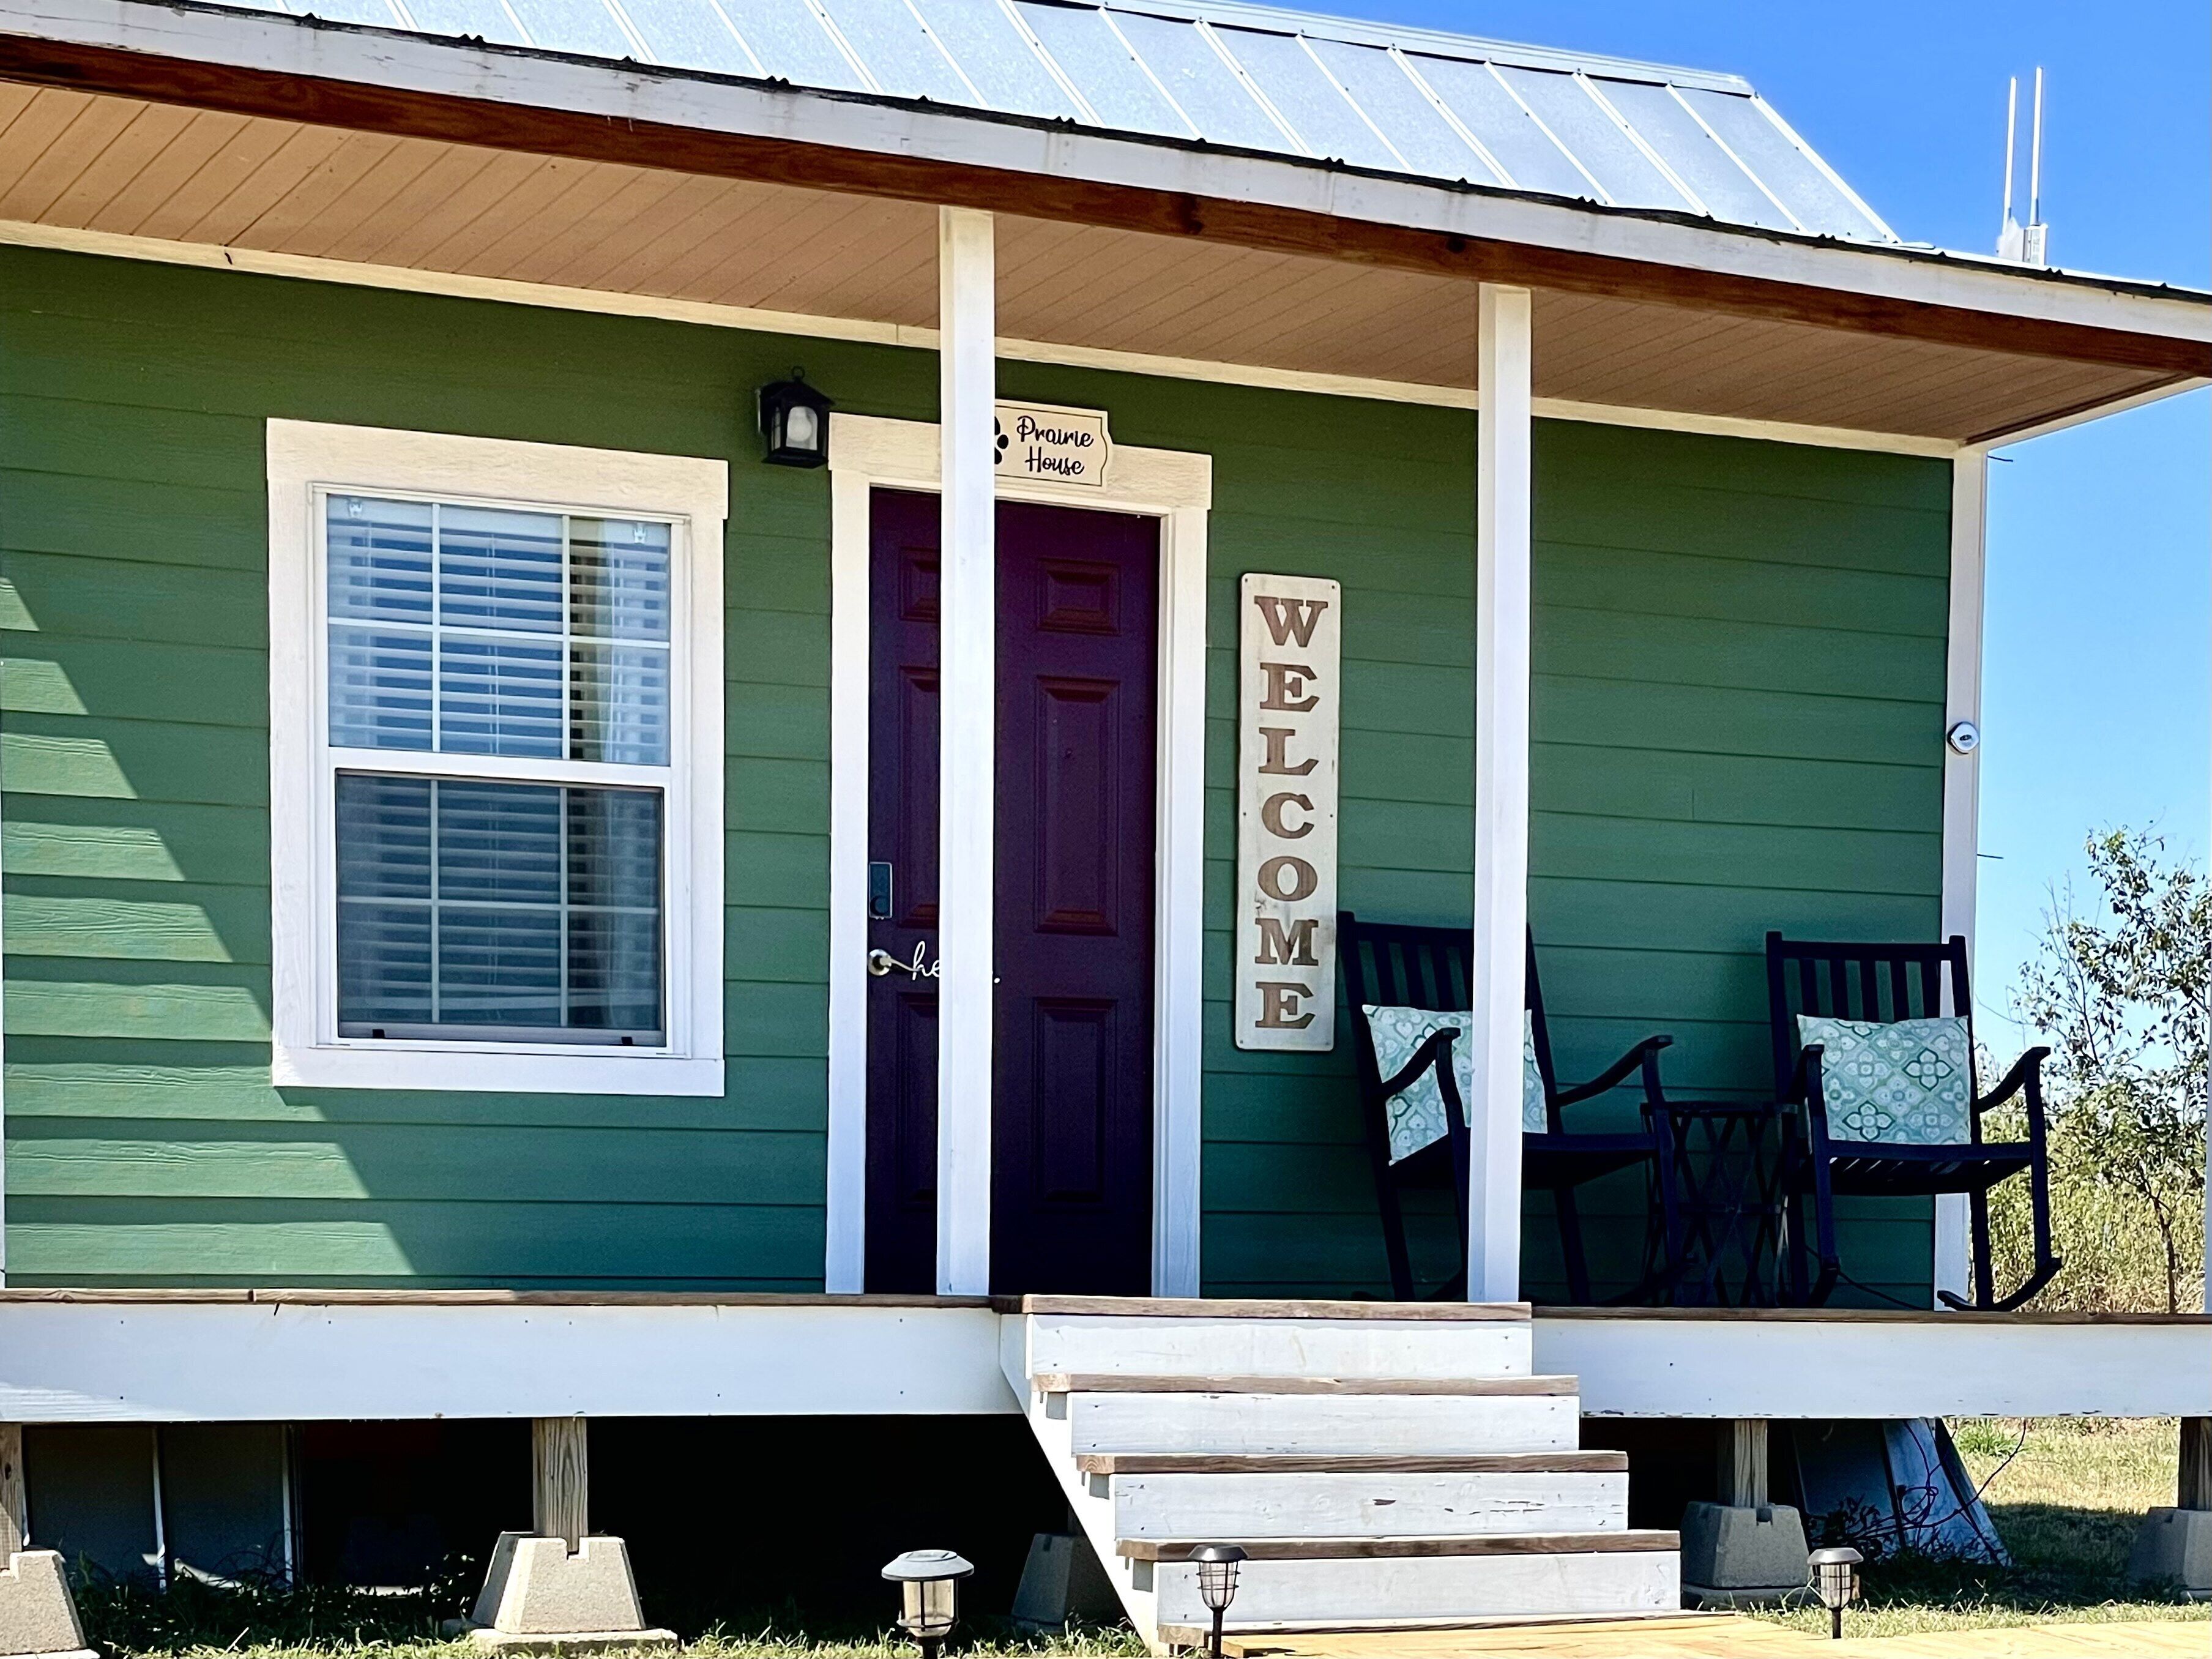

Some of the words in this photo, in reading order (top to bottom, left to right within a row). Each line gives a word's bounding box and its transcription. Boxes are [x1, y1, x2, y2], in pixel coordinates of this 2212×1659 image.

[1016, 415, 1094, 447] Prairie
[1024, 446, 1085, 475] House
[1254, 595, 1329, 1029] WELCOME
